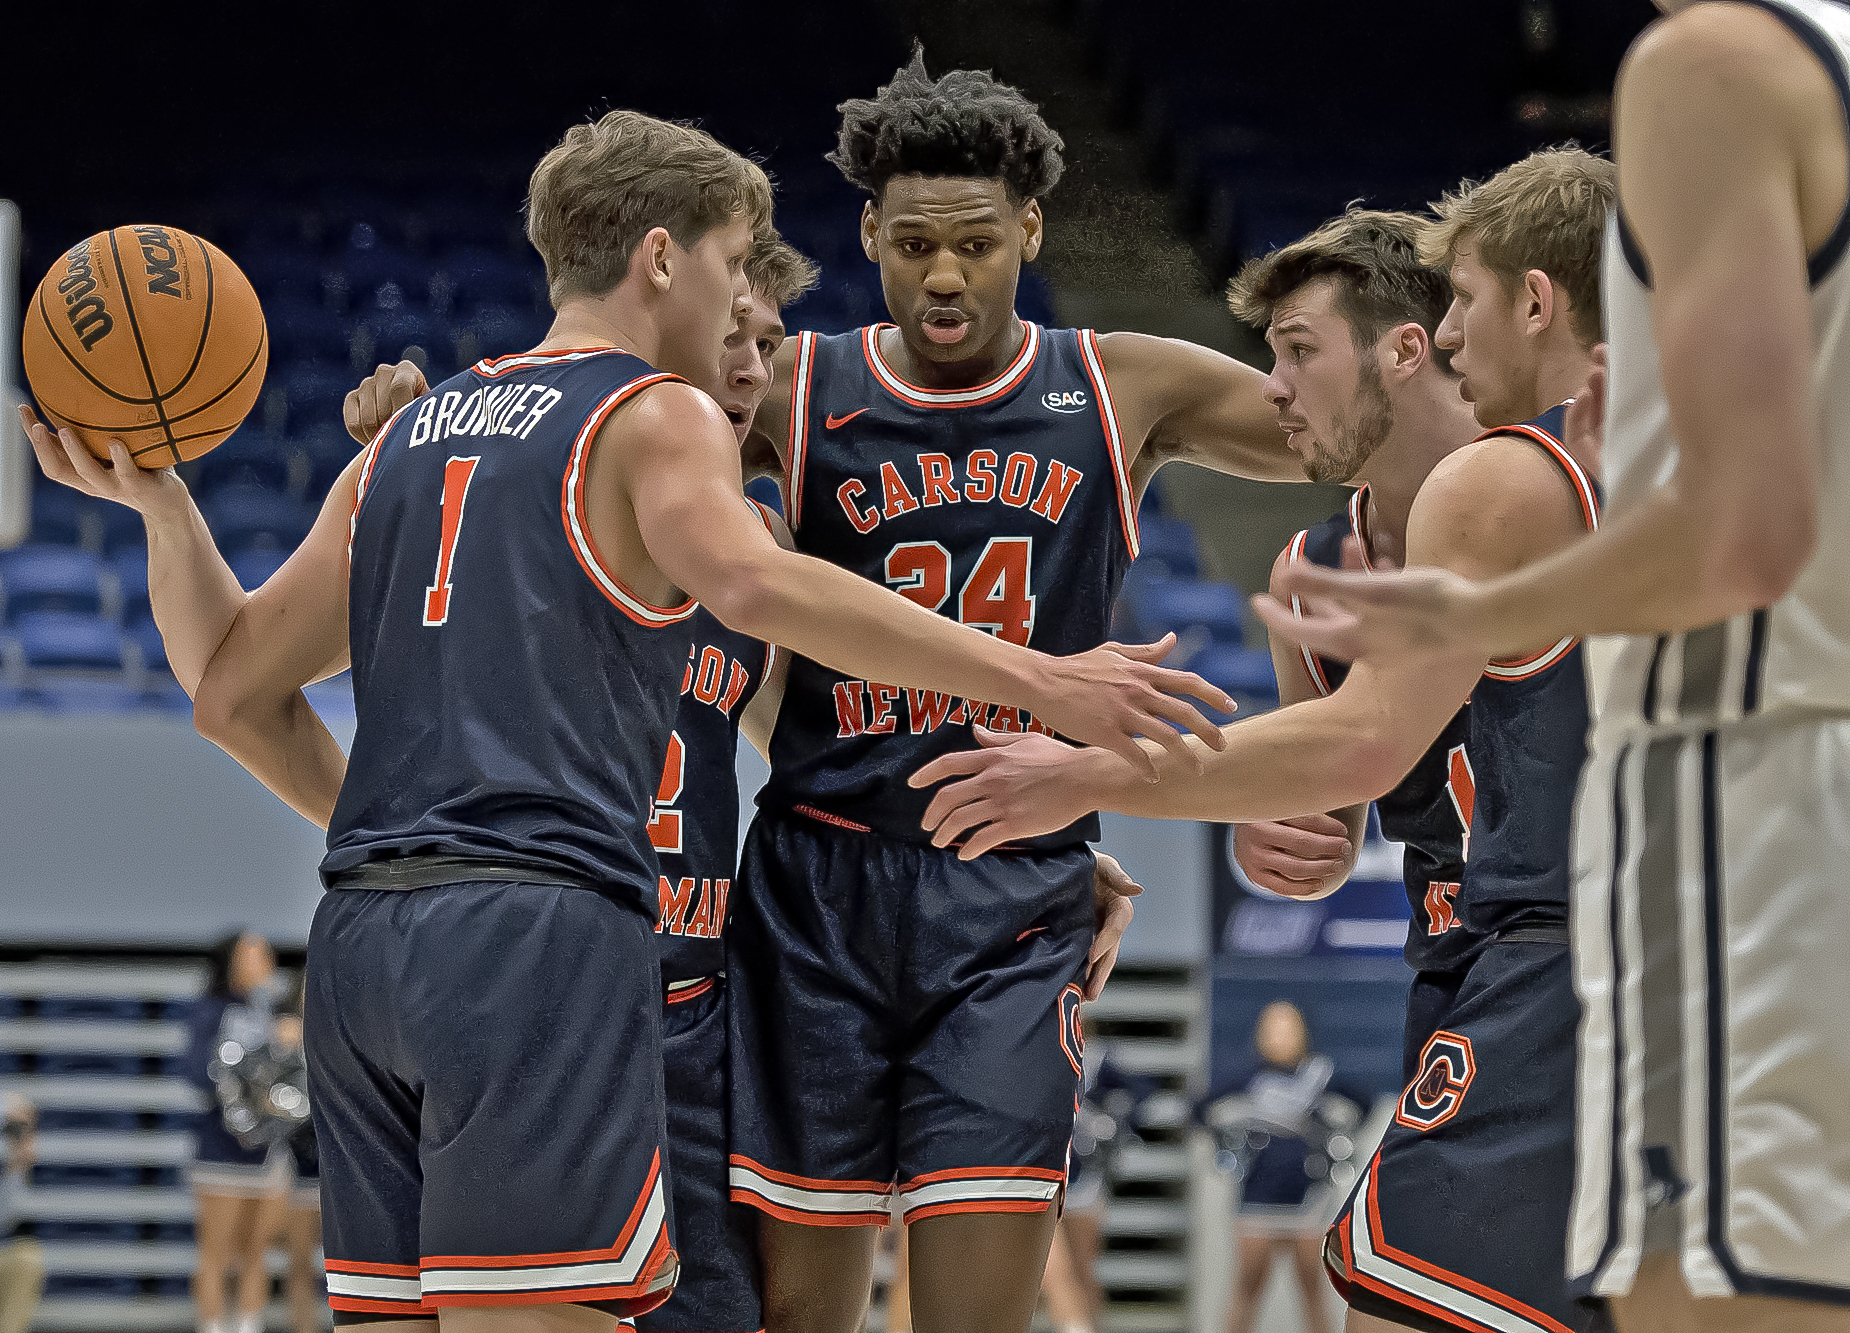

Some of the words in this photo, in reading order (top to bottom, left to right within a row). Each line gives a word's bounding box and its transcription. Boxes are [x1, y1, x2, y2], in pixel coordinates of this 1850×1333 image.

[1047, 390, 1088, 407] SAC
[836, 449, 1084, 534] CARSON
[422, 455, 482, 627] 1
[884, 536, 1037, 648] 24
